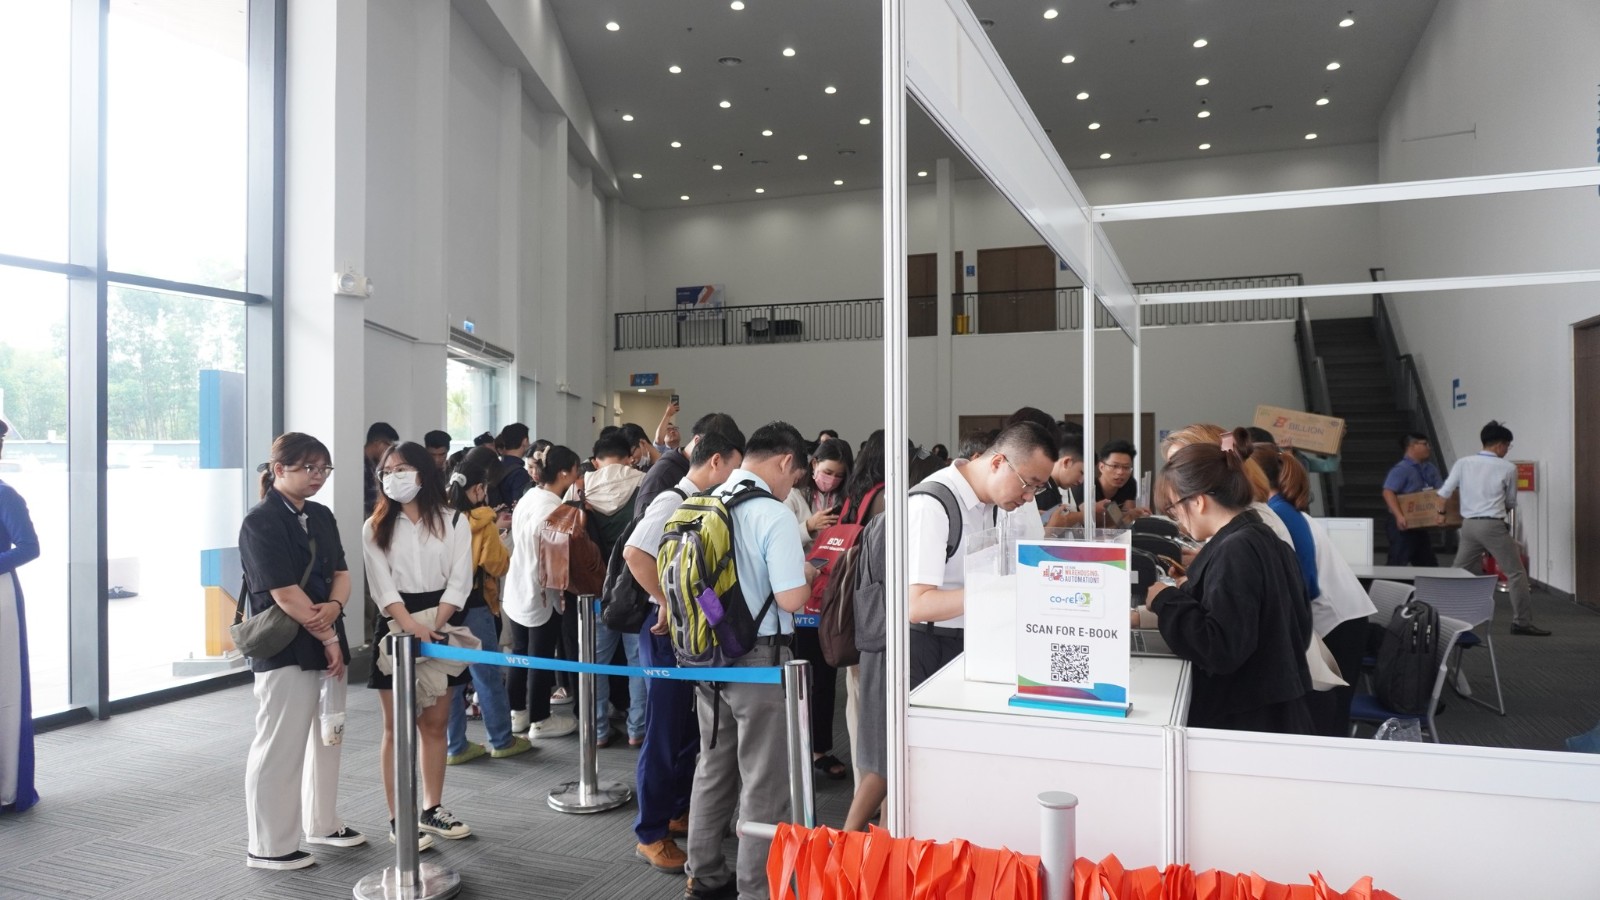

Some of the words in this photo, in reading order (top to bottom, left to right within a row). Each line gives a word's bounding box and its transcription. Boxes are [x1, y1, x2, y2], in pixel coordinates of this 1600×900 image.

[1289, 422, 1324, 434] BILLION
[795, 617, 815, 625] WTC
[1025, 623, 1053, 634] SCAN
[1055, 625, 1076, 636] FOR
[1078, 627, 1118, 639] E-BOOK
[505, 655, 530, 666] WTC
[643, 669, 671, 678] WTC
